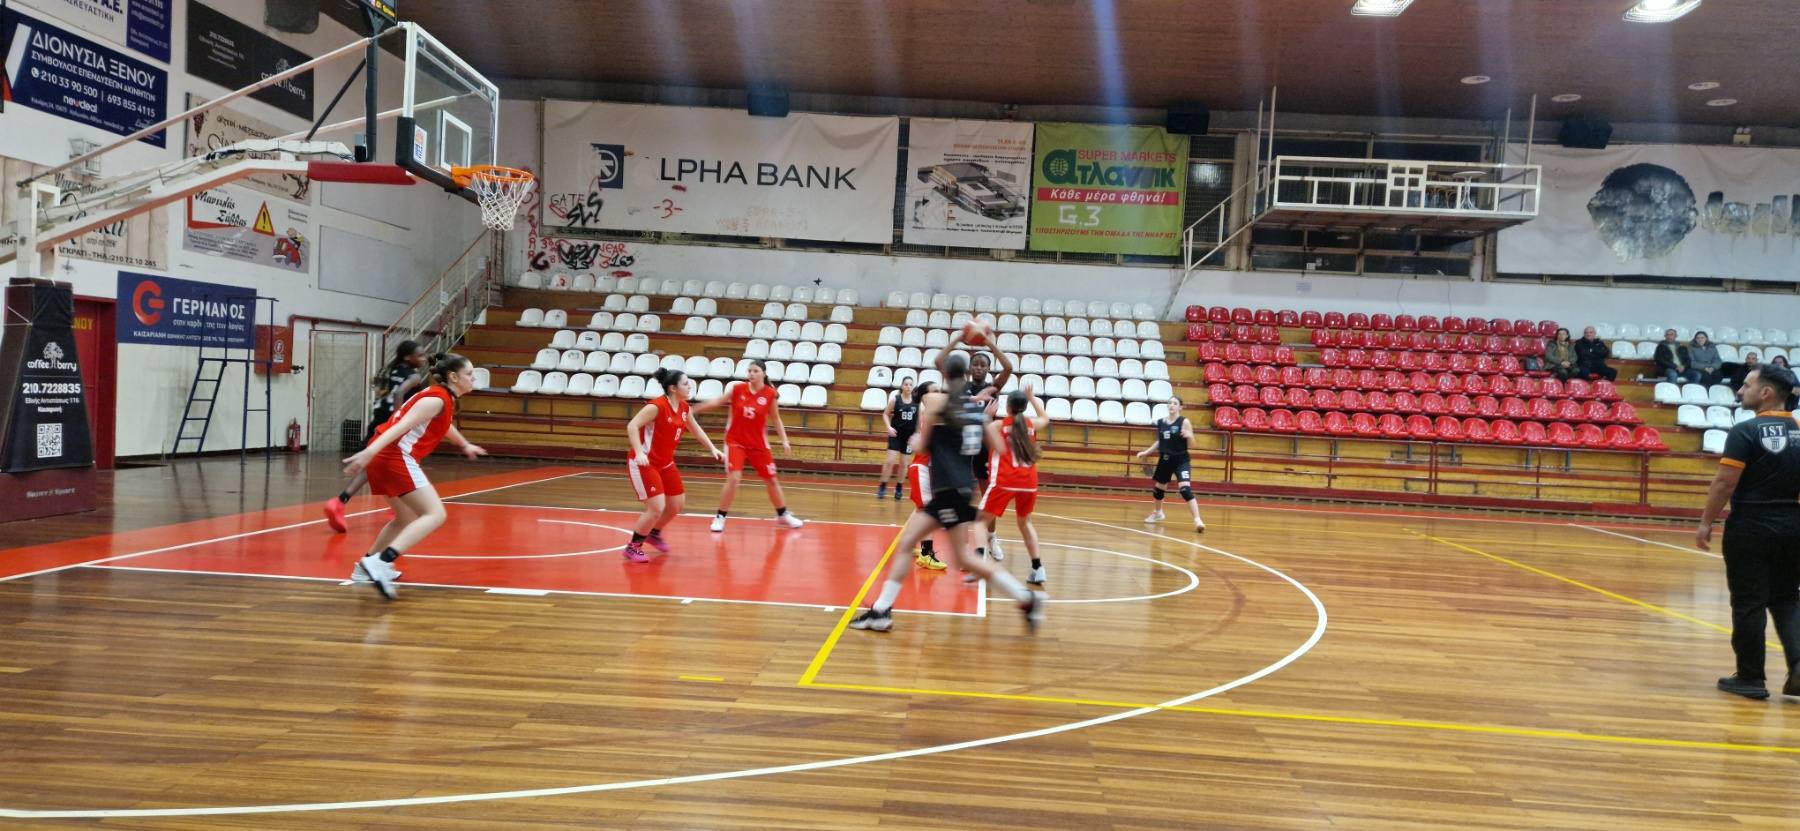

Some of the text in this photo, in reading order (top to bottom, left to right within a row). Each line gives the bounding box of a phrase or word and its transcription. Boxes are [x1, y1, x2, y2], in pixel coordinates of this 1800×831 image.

[32, 30, 106, 72] ΔΙΟΝΥΣΙΑ
[109, 58, 156, 90] ΞΕΝΟΥ
[31, 50, 156, 102] ΣΥΜΒΟΥΛΟΣ ΕΠΕΝΔΥΣΕΩΝ ΑΚΙΝΗΤΩΝ
[40, 70, 156, 118] 210 33 90 500 693 855 4115
[1078, 149, 1177, 163] SUPER MARKETS
[660, 157, 857, 191] LPHA BANK
[1050, 188, 1166, 205] Κάθε μέρα φθηνά!
[172, 297, 246, 319] ΓΕΡΜΑΝΟΣ
[73, 317, 94, 330] ΝΟΥ
[27, 359, 77, 372] coffee berry
[22, 382, 81, 394] 210.7228835
[1762, 425, 1784, 437] IST
